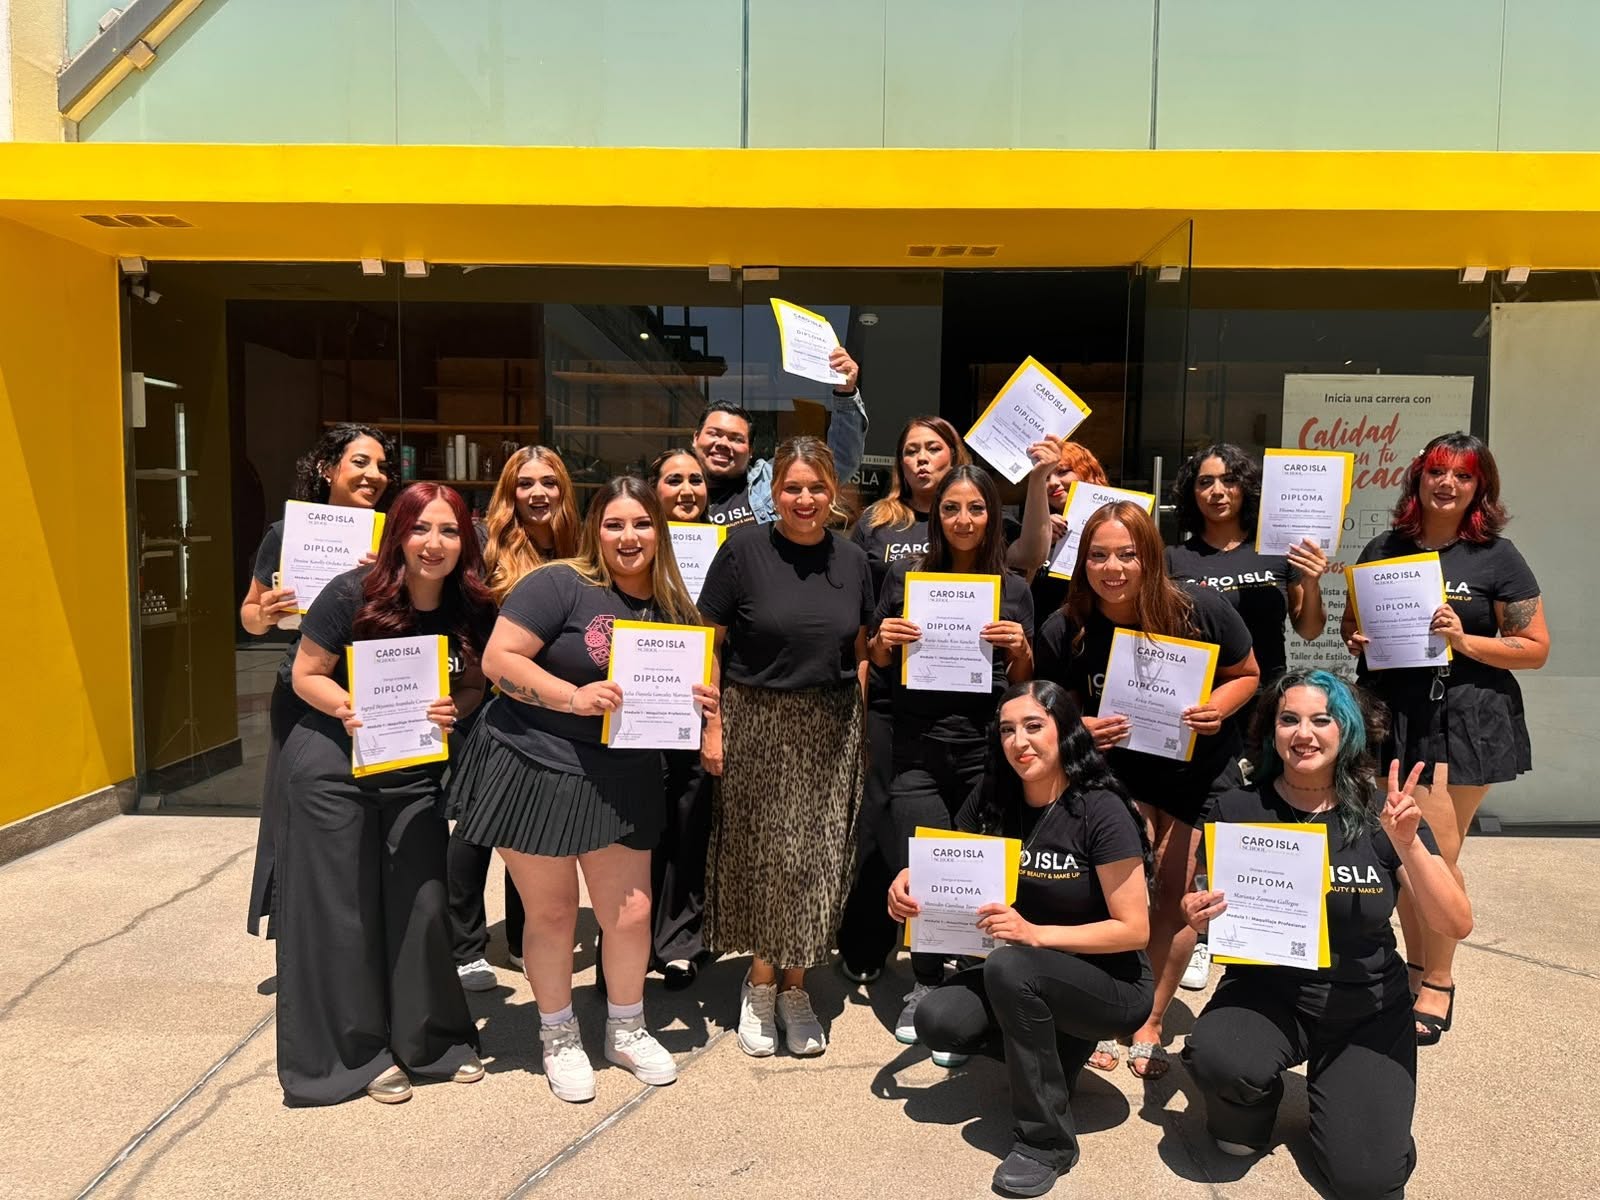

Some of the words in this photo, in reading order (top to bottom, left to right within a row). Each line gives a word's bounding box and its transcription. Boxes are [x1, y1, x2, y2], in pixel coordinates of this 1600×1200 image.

[1036, 383, 1054, 402] CARO
[1052, 398, 1068, 414] ISLA
[1324, 393, 1351, 403] Inicia
[1354, 395, 1373, 404] una
[1376, 395, 1410, 404] carrera
[1014, 404, 1045, 434] DIPLOMA
[1298, 412, 1401, 450] Calidad
[1378, 443, 1398, 466] tu
[1284, 464, 1308, 472] CARO
[849, 471, 879, 486] SLA
[1092, 493, 1115, 504] CARO
[1280, 494, 1323, 502] DIPLOMA
[308, 512, 334, 522] CARO
[336, 515, 354, 524] ISLA
[728, 506, 752, 521] ISL
[1370, 513, 1378, 522] C
[304, 544, 350, 554] DIPLOMA
[1238, 570, 1276, 584] ISLA
[1374, 572, 1400, 581] CARO
[1400, 570, 1421, 579] ISLA
[1446, 582, 1471, 594] LA
[930, 590, 956, 598] CARO
[956, 591, 976, 599] ISLA
[1376, 602, 1420, 612] DIPLOMA
[926, 622, 972, 631] DIPLOMA
[637, 638, 664, 648] CARO
[666, 640, 686, 649] ISLA
[1304, 640, 1344, 649] Maquillaje
[376, 648, 402, 658] CARO
[402, 646, 421, 656] ISLA
[1137, 646, 1165, 659] CARO
[1166, 652, 1187, 664] ISLA
[1313, 652, 1324, 660] de
[1326, 652, 1352, 660] Estilos
[634, 674, 680, 683] DIPLOMA
[374, 682, 418, 694] DIPLOMA
[1128, 680, 1176, 696] DIPLOMA
[1242, 836, 1274, 848] CARO
[1276, 840, 1300, 851] ISLA
[933, 848, 962, 857] CARO
[962, 849, 984, 858] ISLA
[1034, 852, 1079, 870] ISLA
[1027, 870, 1046, 878] BEAUTY
[1329, 866, 1381, 884] ISLA
[1237, 874, 1294, 890] DIPLOMA
[932, 884, 982, 896] DIPLOMA
